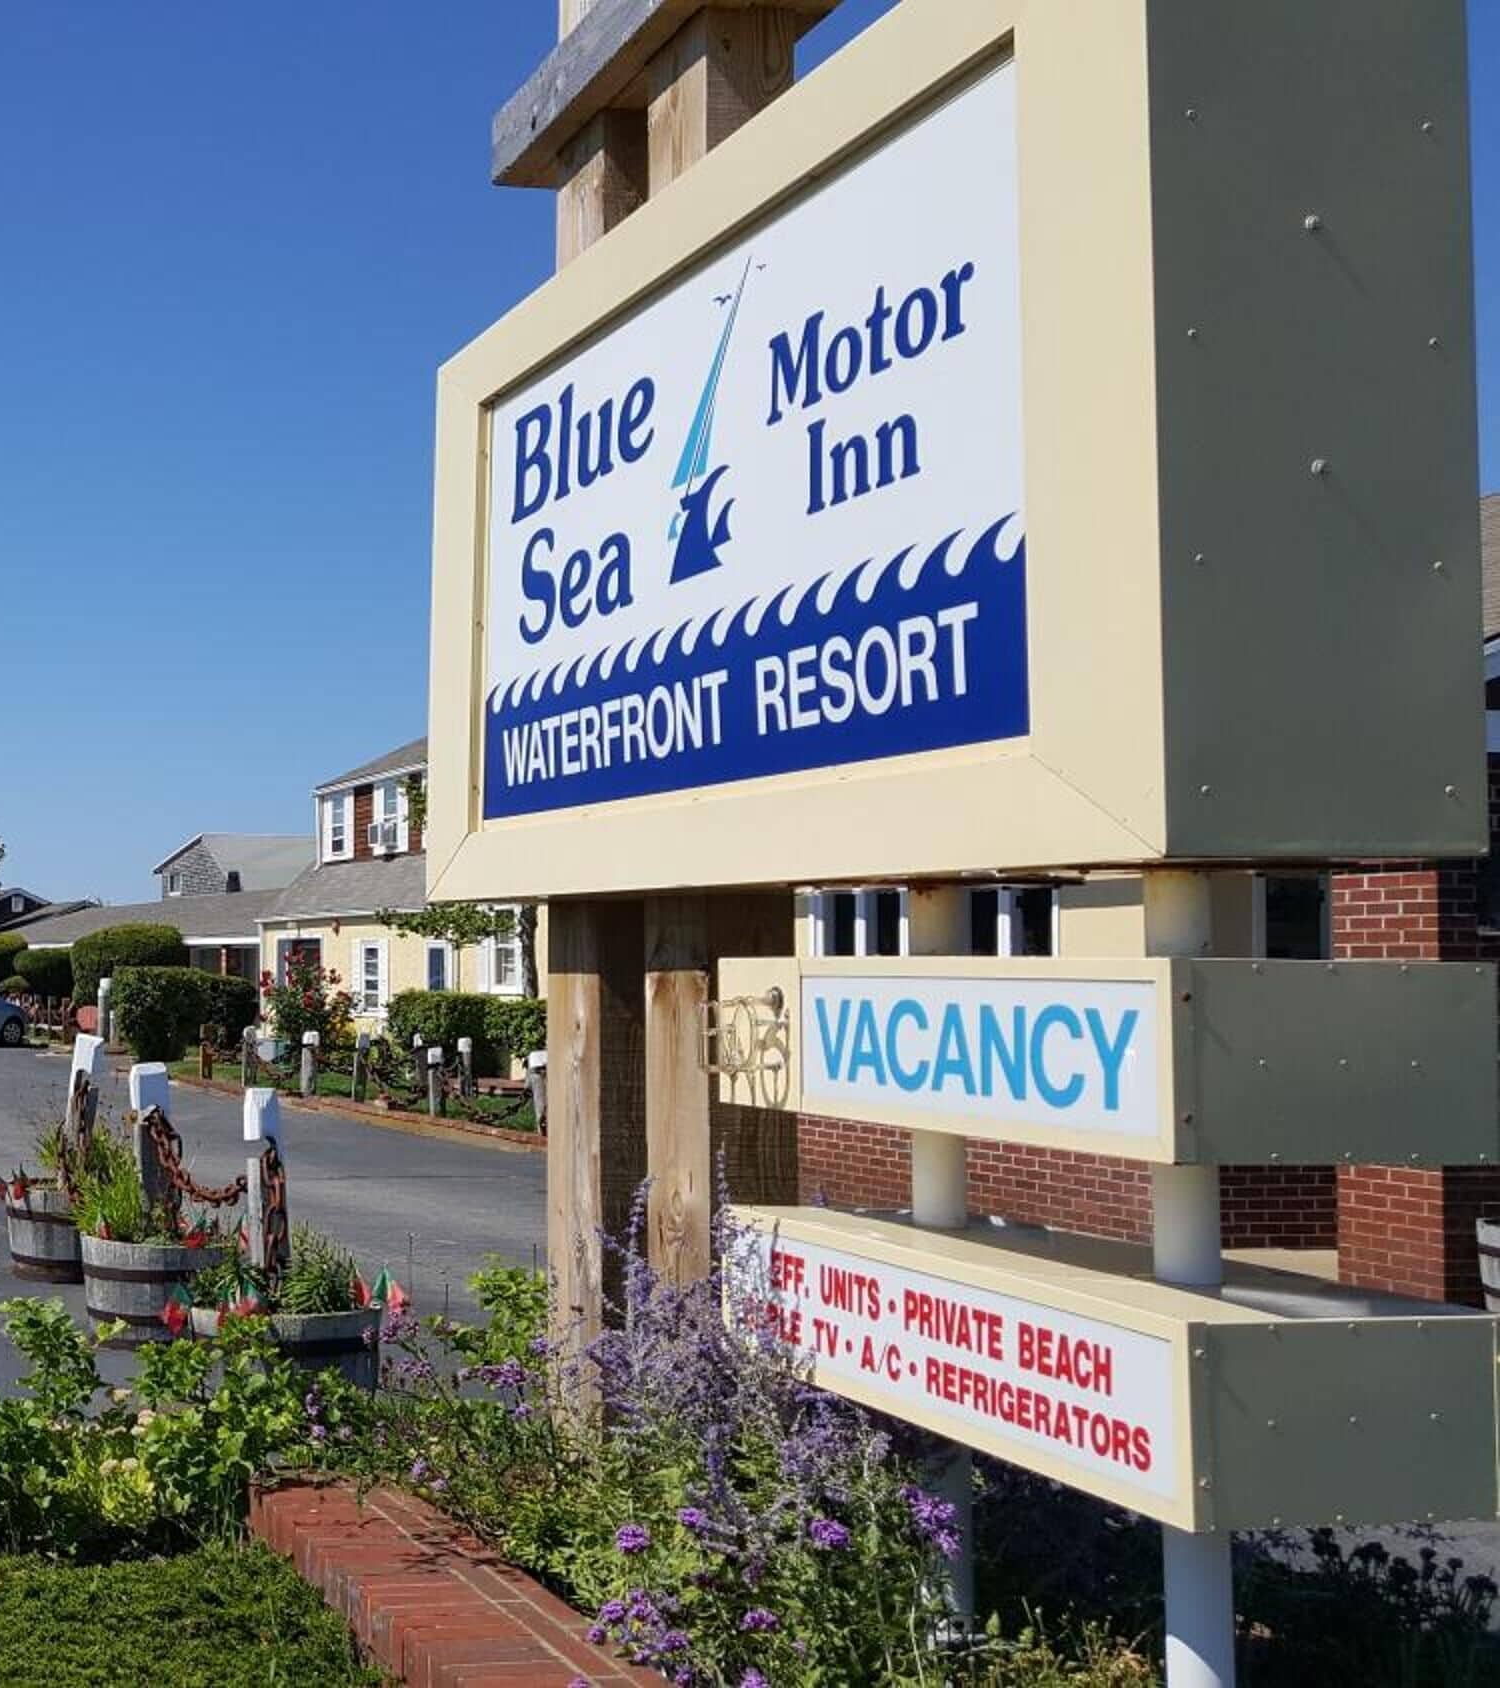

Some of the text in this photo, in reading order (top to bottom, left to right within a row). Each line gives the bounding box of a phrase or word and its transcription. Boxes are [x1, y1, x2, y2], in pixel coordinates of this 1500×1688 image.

[767, 261, 976, 426] Motor
[511, 375, 656, 525] Blue
[806, 411, 922, 516] Inn
[518, 527, 634, 645] Sea
[503, 602, 980, 787] WATERFRONT RESORT
[815, 997, 1140, 1111] VACANCY
[770, 1249, 1112, 1396] EFF. UNITS PRIVATE BEACH
[812, 1317, 840, 1358] TV
[860, 1334, 902, 1383] A/C
[926, 1356, 1153, 1473] REFRIGERATORS
